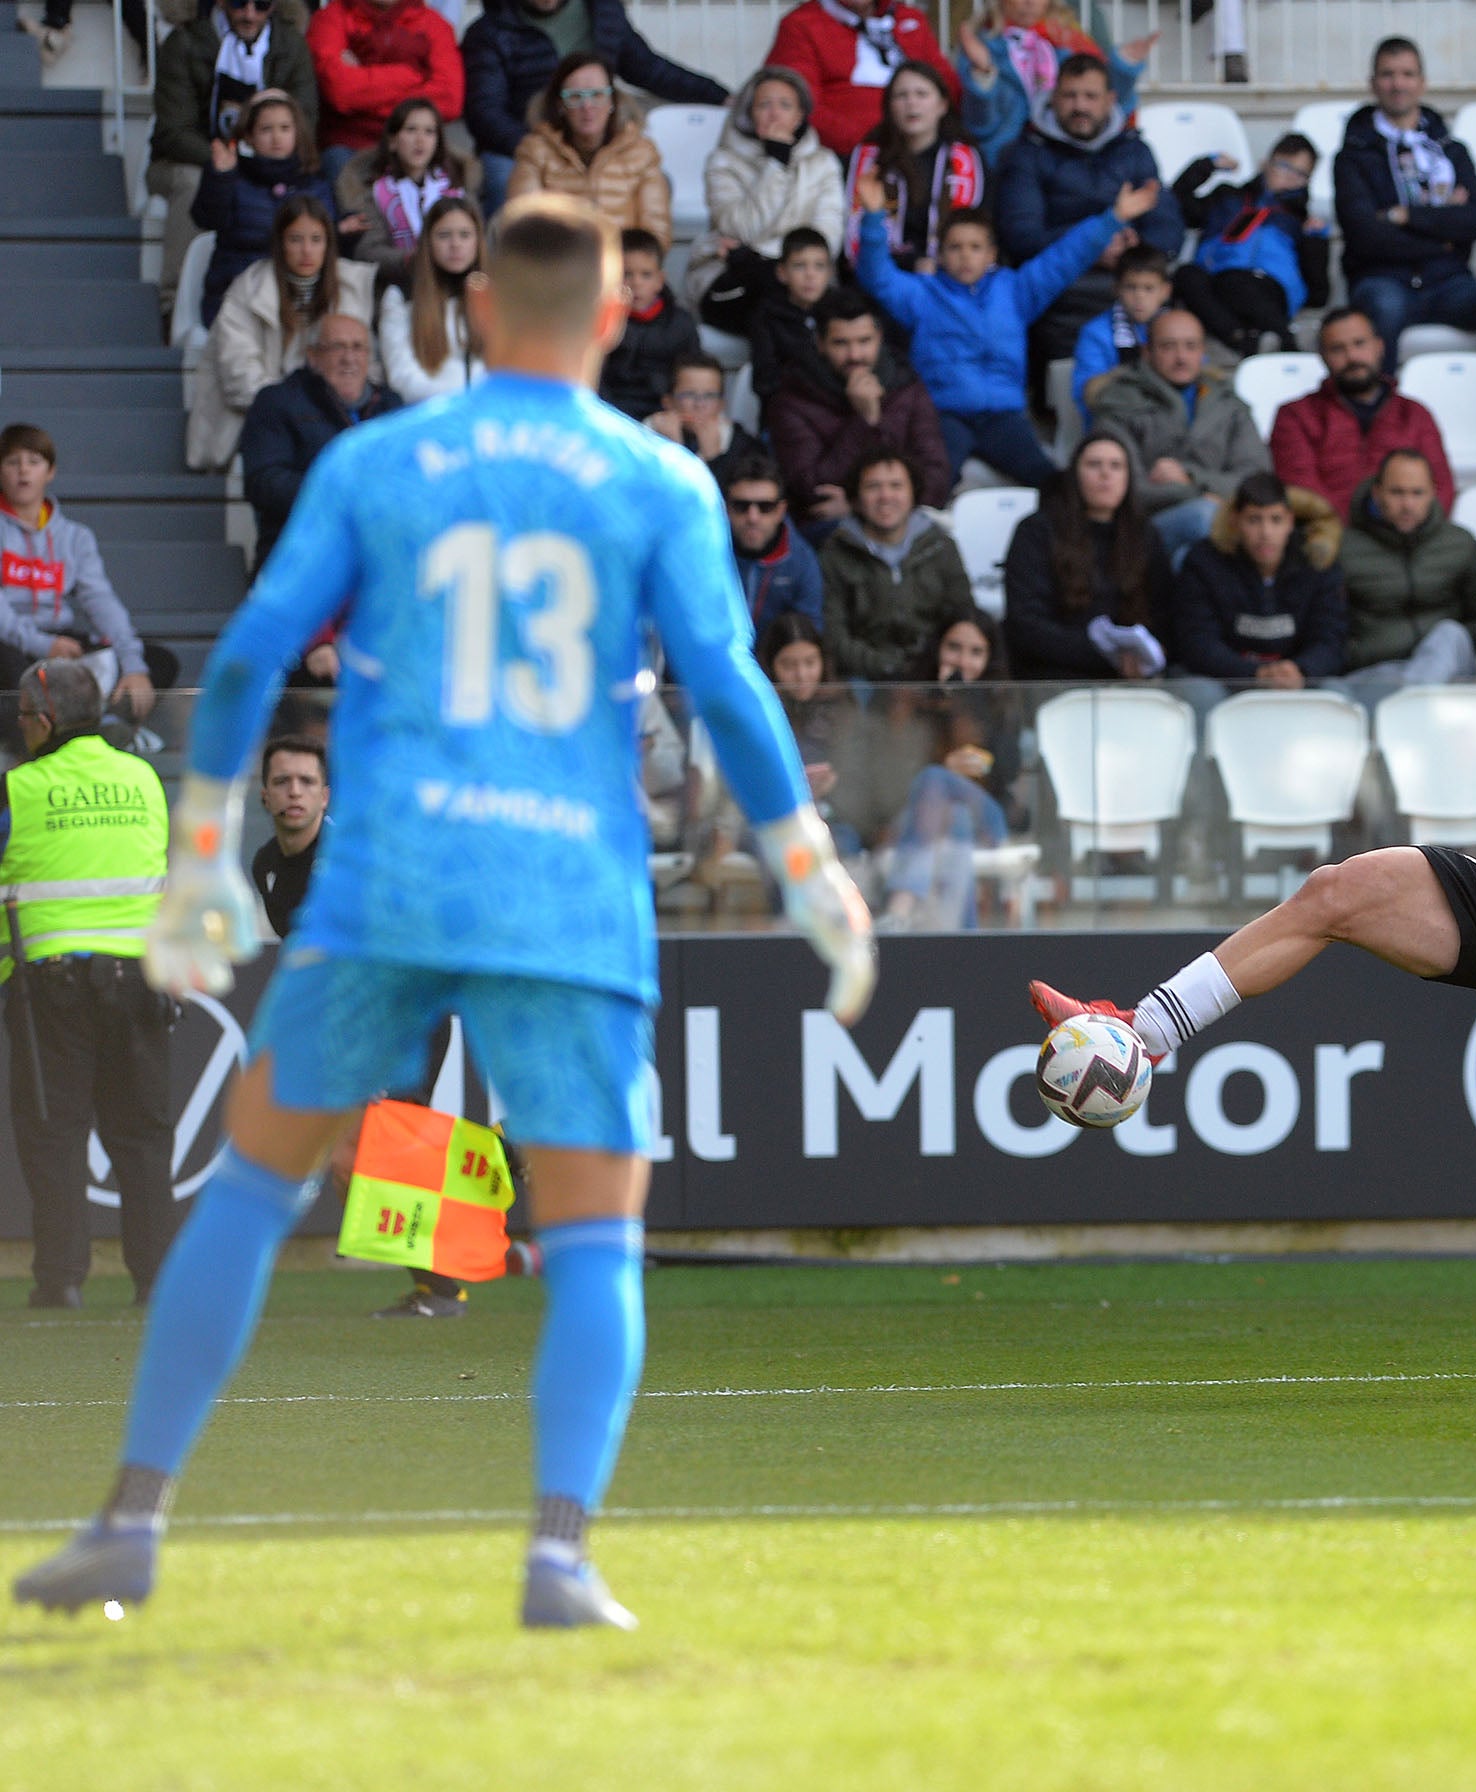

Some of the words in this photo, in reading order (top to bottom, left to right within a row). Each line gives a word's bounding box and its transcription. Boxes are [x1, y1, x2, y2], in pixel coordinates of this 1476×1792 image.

[416, 520, 599, 735] 13
[47, 783, 146, 808] GARDA
[46, 815, 149, 832] SEGURIDAD
